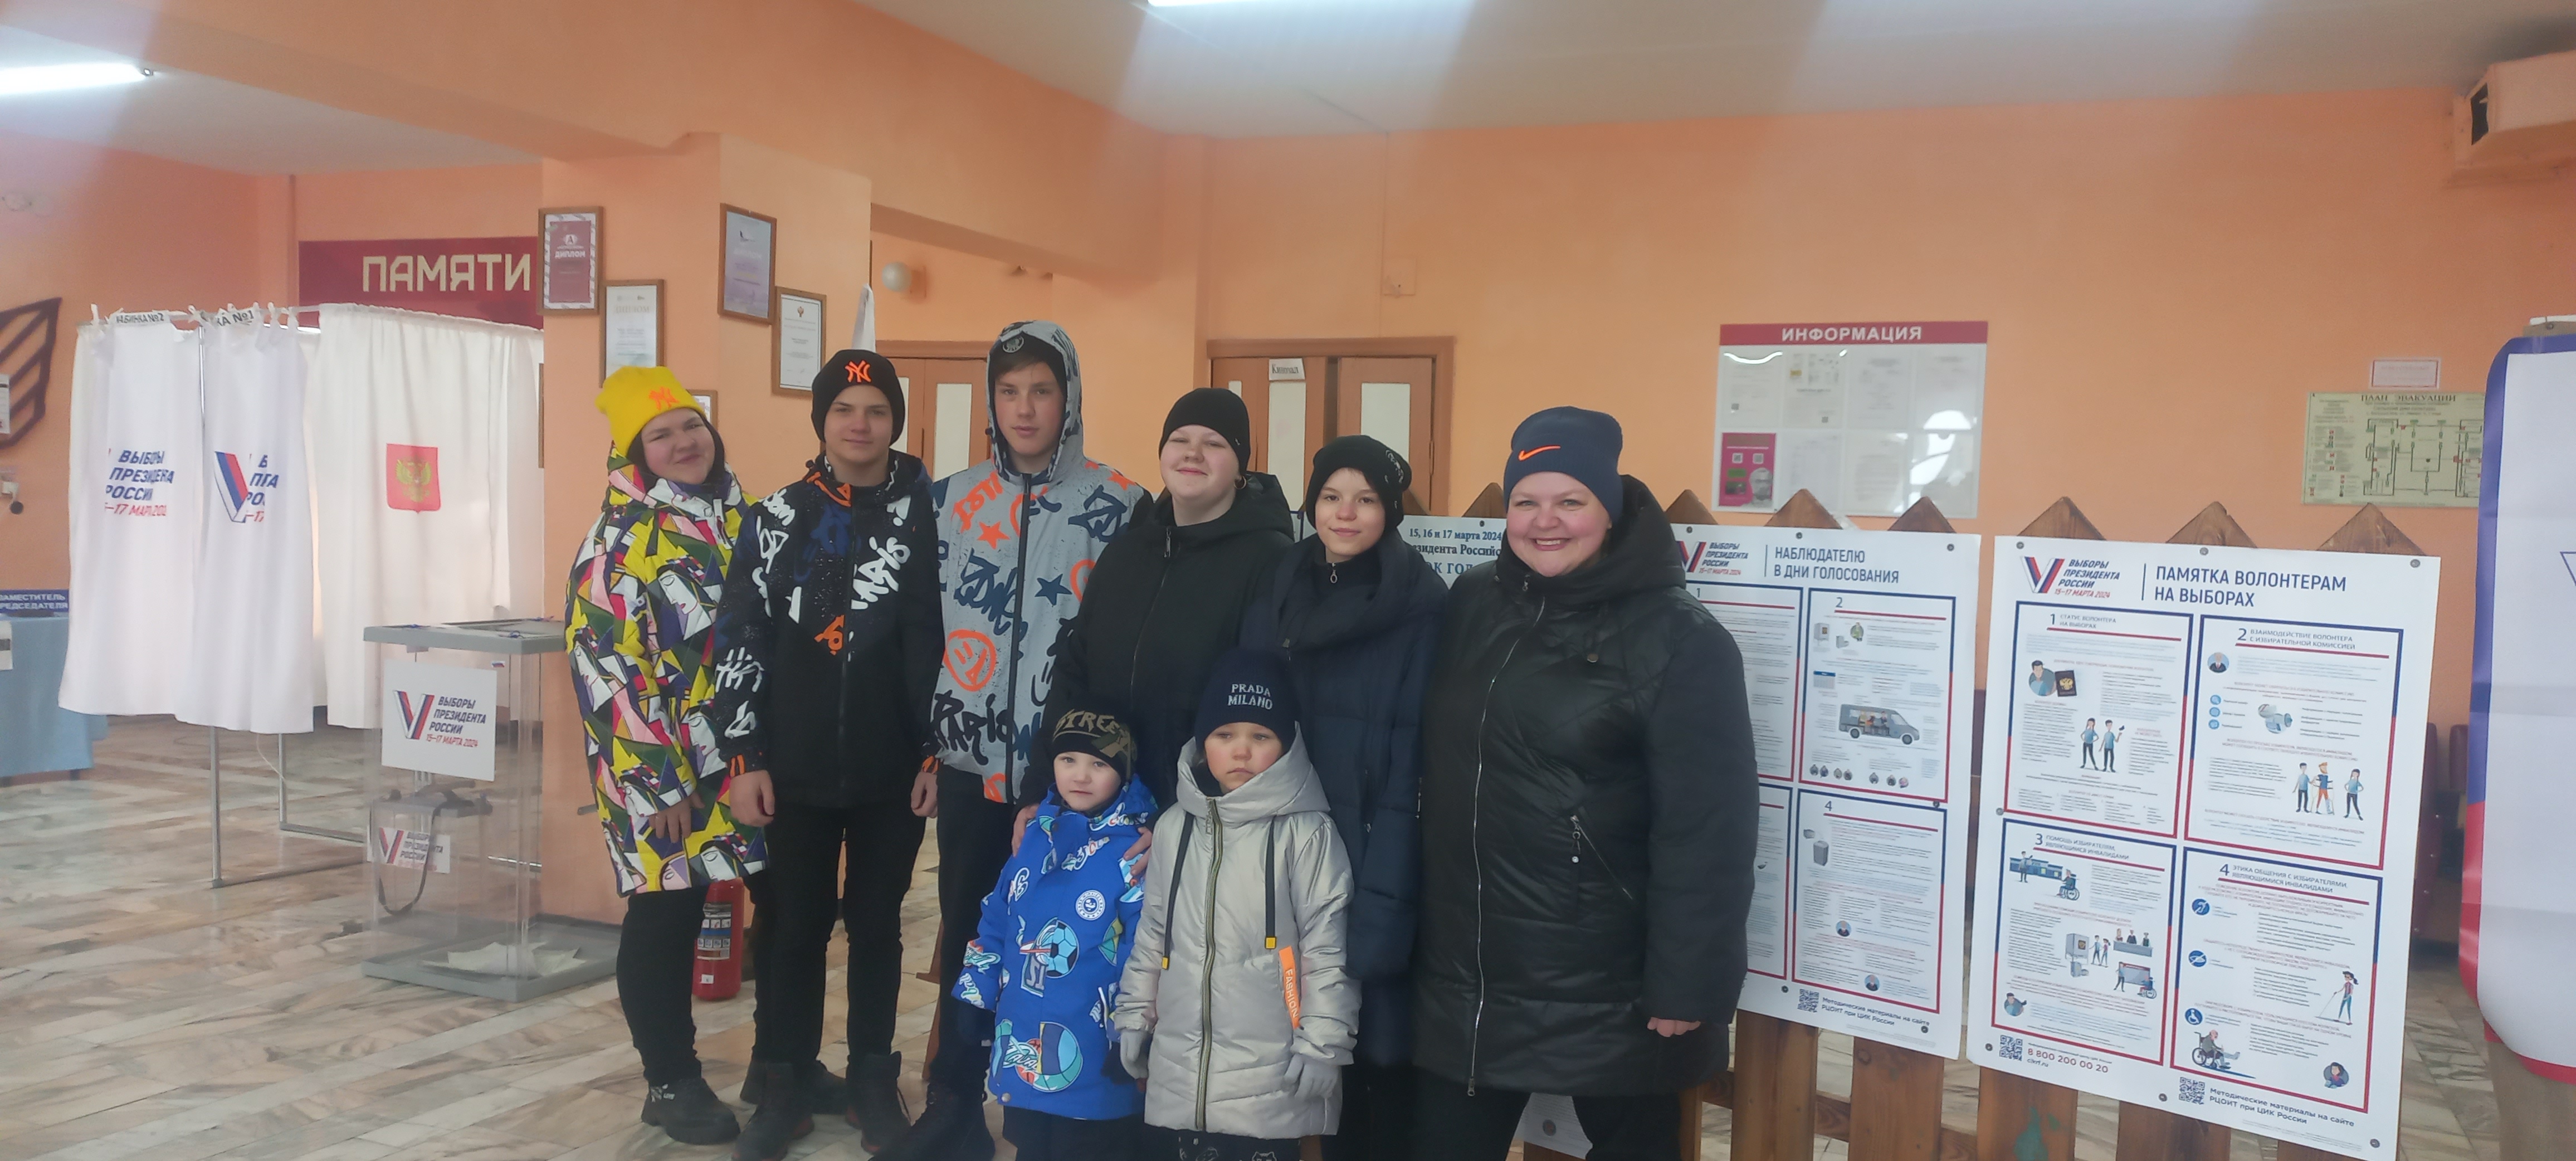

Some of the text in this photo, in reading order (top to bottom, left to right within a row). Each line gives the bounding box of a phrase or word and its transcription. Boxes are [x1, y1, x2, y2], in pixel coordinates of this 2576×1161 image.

[362, 253, 531, 292] ПАМЯТИ
[1782, 326, 1923, 343] ИНФОРМАЦИЯ
[1409, 528, 1421, 538] 15,
[1423, 529, 1432, 538] 16
[1443, 530, 1452, 539] 17
[1454, 532, 1480, 542] марта
[1482, 531, 1501, 541] 2024
[1413, 544, 1501, 556] зидента Российс
[1705, 551, 1749, 559] ПРЕЗИДЕНТА
[1775, 547, 1865, 563] НАБЛЮДАТЕЛЮ
[2068, 559, 2109, 568] ВЫБОРЫ
[1774, 564, 1899, 583] В ДНИ ГОЛОСОВАНИЯ
[2063, 569, 2120, 580] ПРЕЗИДЕНТА
[2157, 566, 2346, 592] ПАМЯТКА ВОЛОНТЕРАМ
[2058, 579, 2095, 588] РОССИИ
[1697, 588, 1700, 598] 1
[2155, 587, 2255, 607] НА ВЫБОРАХ
[1836, 597, 1843, 608] 2
[2050, 613, 2055, 625] 1
[2237, 628, 2247, 641] 2
[2250, 629, 2311, 638] ВЗАИМОДЕЙСТВИЕ
[2255, 637, 2311, 647] ИЗБИРАТЕЛЬНОЙ
[1231, 684, 1271, 697] PRADA
[438, 696, 476, 709] ВЫБОРЫ
[1228, 694, 1273, 710] MILANO
[433, 709, 486, 724] ПРЕЗИДЕНТА
[429, 721, 463, 734] РОССИИ
[1824, 801, 1832, 811] 4
[2035, 833, 2043, 845] 3
[2219, 864, 2229, 876] 4
[2255, 869, 2287, 878] ОБЩЕНИЯ
[2285, 880, 2333, 893] ИНВАЛИДАМИ
[1286, 969, 1299, 1018] FASHION
[1822, 997, 1866, 1012] Методические
[1867, 1008, 1901, 1019] материалы
[1872, 1016, 1895, 1026] России
[2036, 1050, 2055, 1061] 800
[2057, 1055, 2077, 1066] 200
[2080, 1060, 2093, 1070] 00
[2095, 1064, 2109, 1073] 20
[2209, 1096, 2238, 1108] РЦОИТ
[2257, 1107, 2274, 1116] ЦИК
[2277, 1111, 2307, 1124] России
[2210, 1087, 2267, 1106] Методические
[2270, 1103, 2315, 1118] материалы
[2330, 1116, 2354, 1127] сайте
